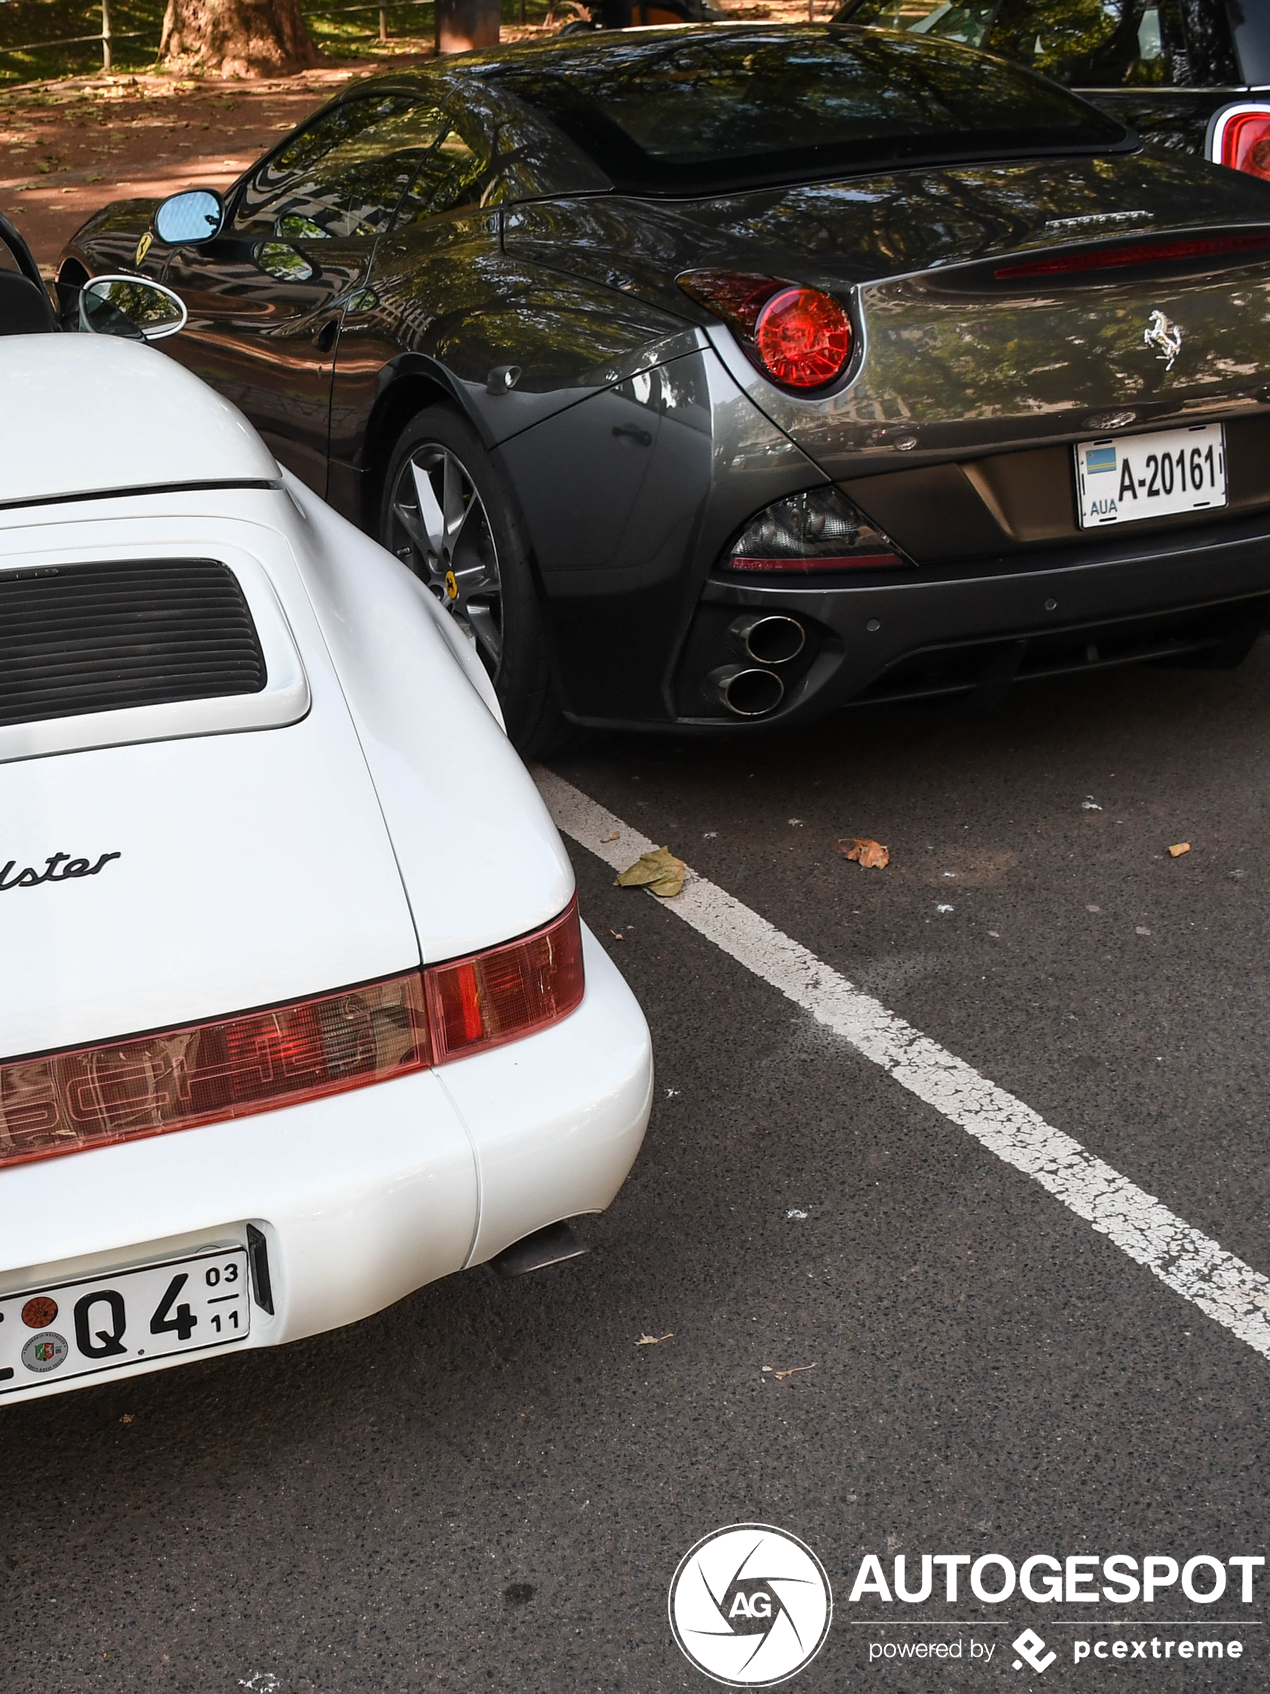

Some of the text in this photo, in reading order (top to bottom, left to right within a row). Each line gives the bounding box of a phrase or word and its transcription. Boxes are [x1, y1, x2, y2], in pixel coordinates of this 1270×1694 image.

[1118, 445, 1215, 501] A-20161
[1090, 498, 1118, 516] AUA
[205, 1263, 238, 1287] 03
[73, 1289, 128, 1359] Q
[150, 1273, 197, 1340] 4
[210, 1310, 238, 1332] 11
